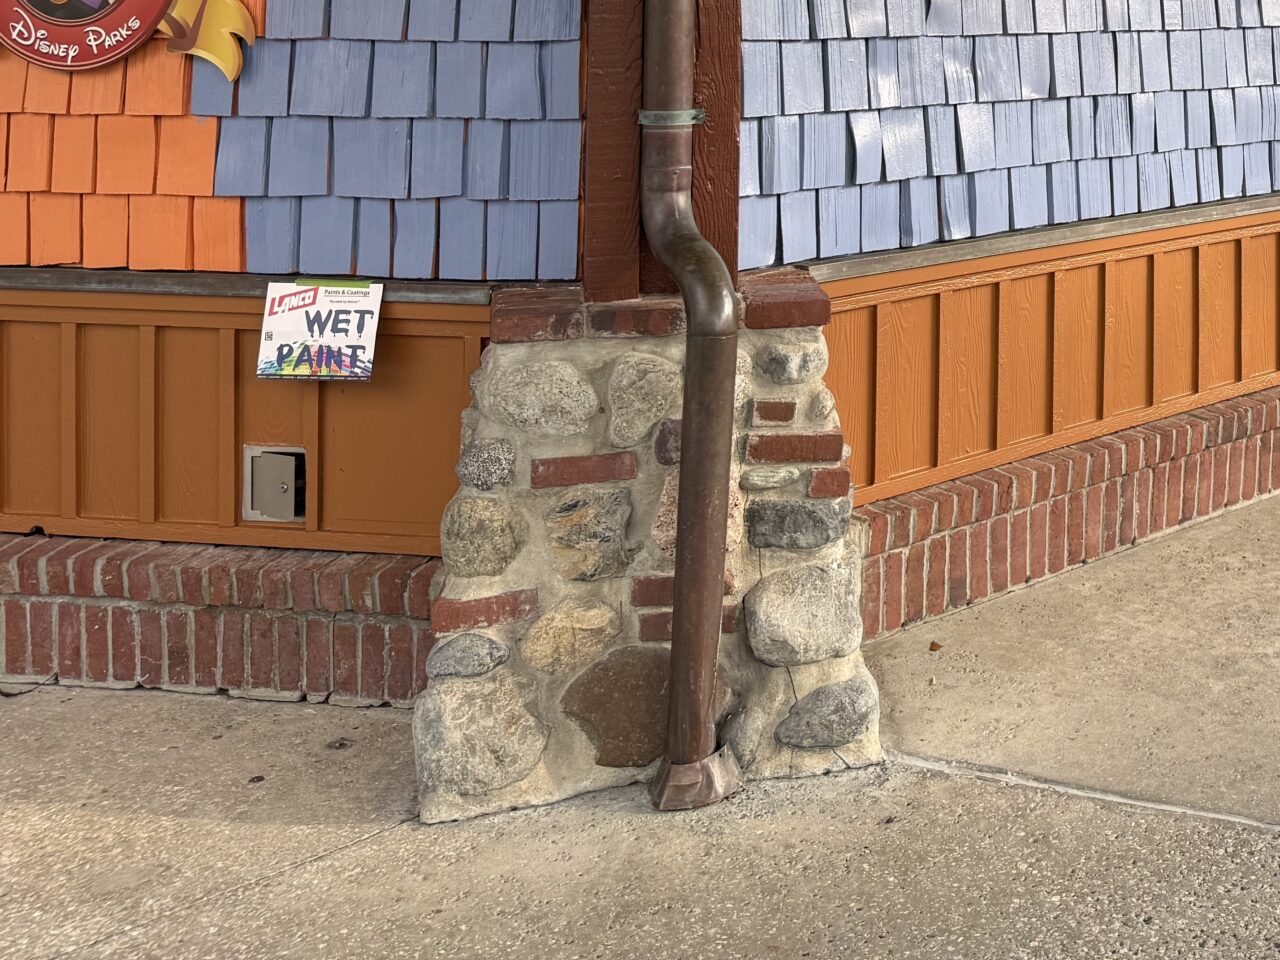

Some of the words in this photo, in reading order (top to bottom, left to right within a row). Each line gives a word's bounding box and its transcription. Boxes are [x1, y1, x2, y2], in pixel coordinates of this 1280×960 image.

[269, 288, 316, 316] LANCO
[346, 289, 370, 297] Coatings
[305, 309, 374, 338] WET
[276, 343, 366, 373] PAINT
